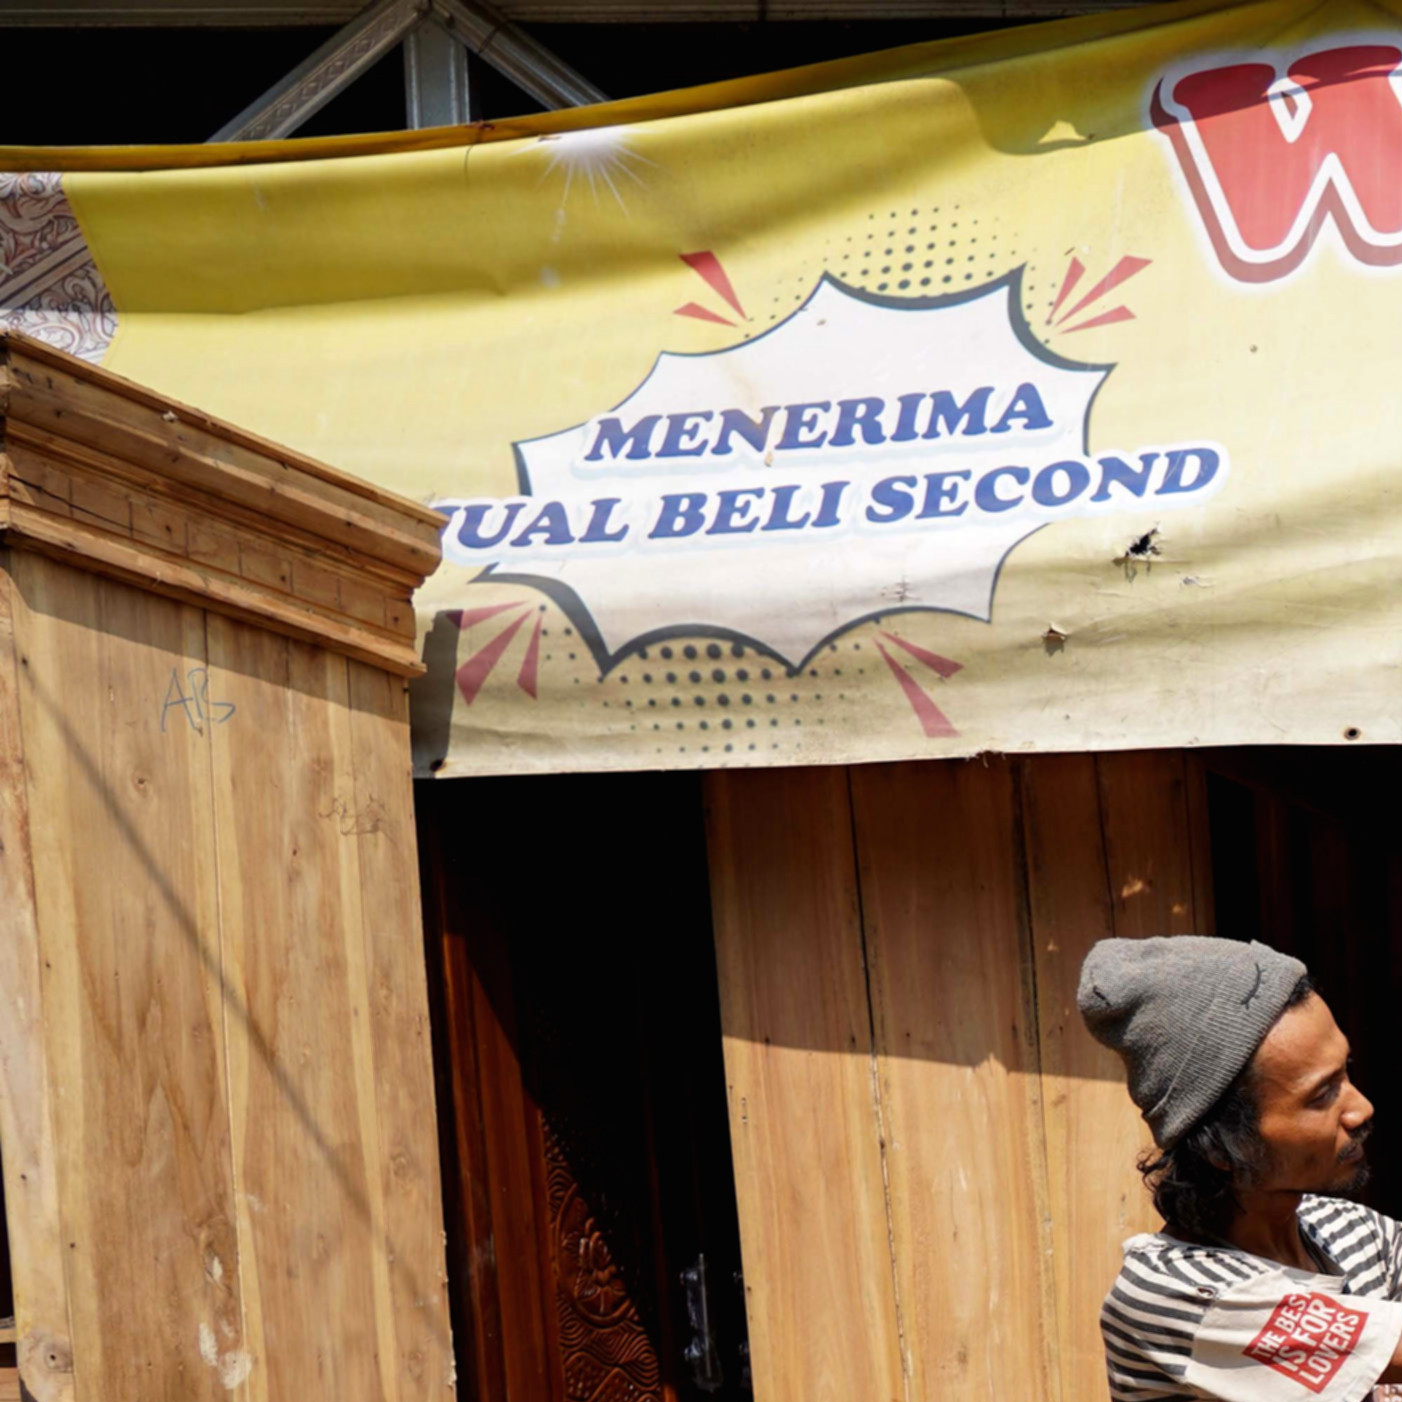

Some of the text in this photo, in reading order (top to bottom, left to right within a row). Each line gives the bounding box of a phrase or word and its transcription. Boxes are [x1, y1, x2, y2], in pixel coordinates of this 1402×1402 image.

[583, 382, 1054, 462] MENERIMA
[647, 480, 851, 540] BELI
[863, 446, 1222, 523] SECOND
[1252, 1292, 1312, 1358] THE BES
[1272, 1298, 1337, 1372] IS FOR
[1298, 1312, 1360, 1385] LOVERS
